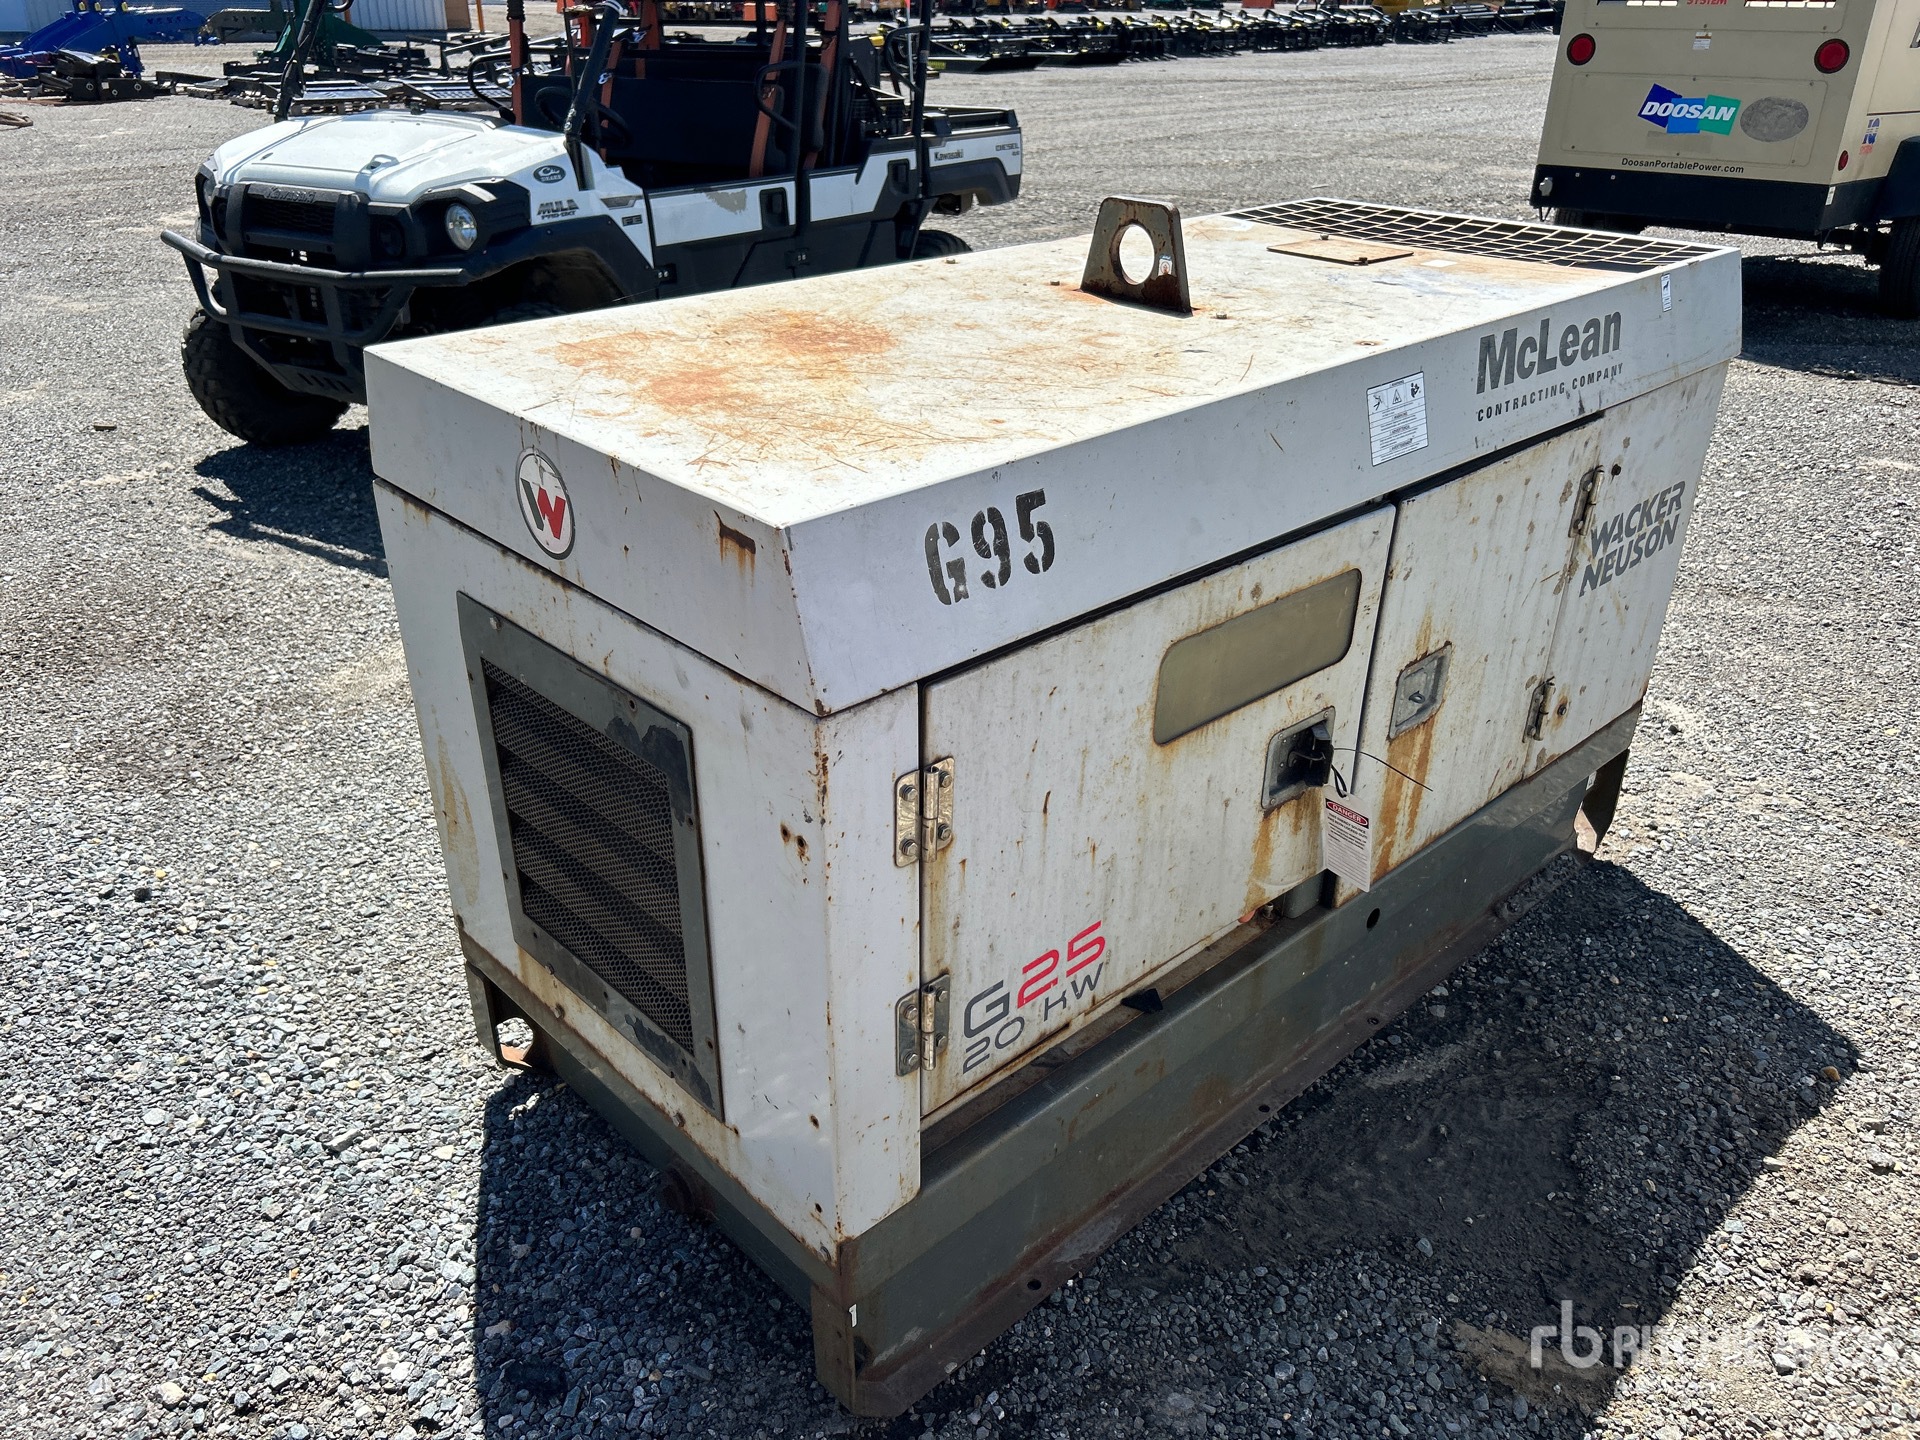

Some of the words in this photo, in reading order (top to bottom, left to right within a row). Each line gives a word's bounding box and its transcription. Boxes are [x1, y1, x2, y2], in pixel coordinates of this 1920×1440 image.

[1641, 101, 1736, 121] DOOSAN
[933, 149, 964, 161] Kawasaki
[995, 143, 1019, 151] DIESEL
[1621, 157, 1745, 174] DoosanPortablePower.com
[1476, 311, 1622, 394] McLean
[1477, 382, 1566, 422] CONTRACTING
[1572, 362, 1624, 391] COMPANY
[923, 488, 1056, 605] G95
[1591, 480, 1686, 558] WACKER
[1579, 514, 1680, 598] NEUSON
[1332, 803, 1362, 823] DANGER
[963, 920, 1106, 1039] G25
[962, 1016, 1025, 1075] 20
